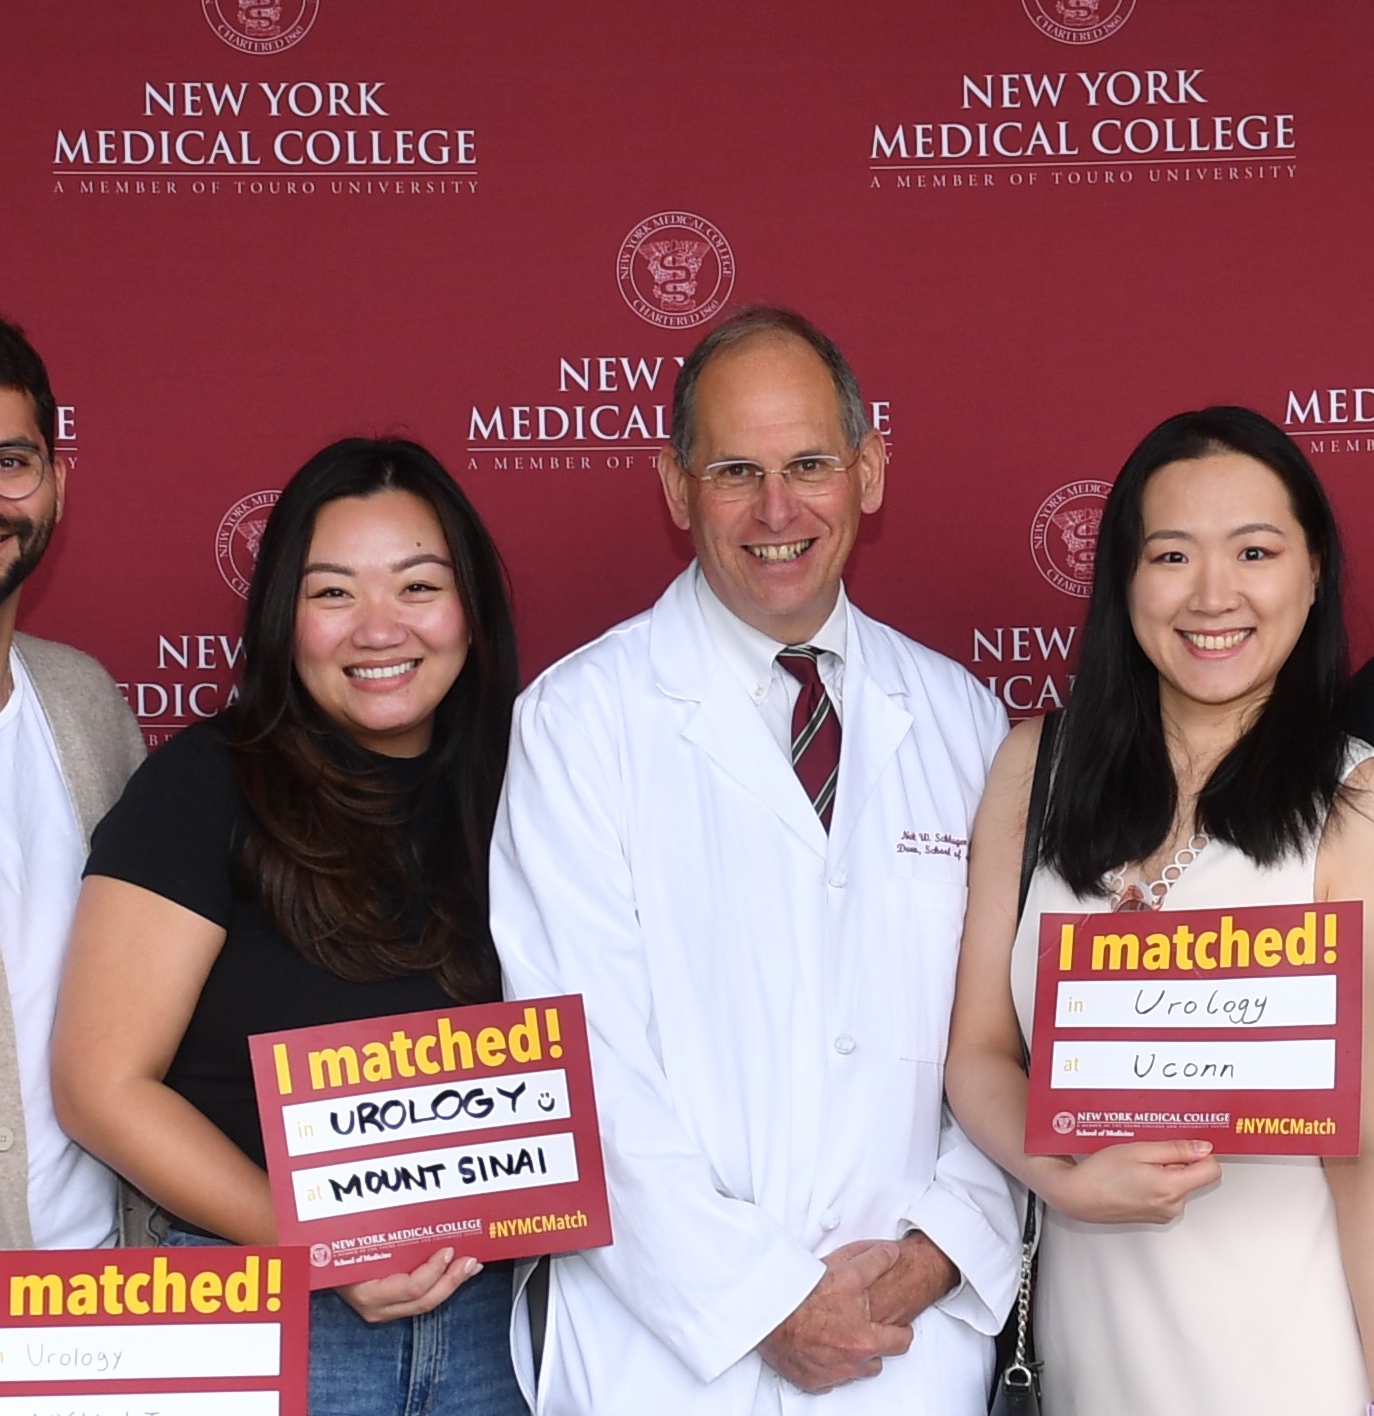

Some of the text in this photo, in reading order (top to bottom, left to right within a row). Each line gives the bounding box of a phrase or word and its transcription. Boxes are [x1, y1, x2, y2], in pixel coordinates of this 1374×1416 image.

[217, 25, 284, 51] CHARTERED
[145, 82, 389, 116] NEW YORK
[963, 70, 1207, 108] NEW YORK
[54, 130, 476, 165] MEDICAL COLLEGE
[871, 115, 1295, 158] MEDICAL COLLEGE
[54, 181, 478, 194] A MEMBER OF TOURO UNIVERSITY
[870, 165, 1296, 188] A MEMBER OF TOURO UNIVERSITY
[559, 357, 663, 391] NEW
[468, 405, 670, 440] MEDICAL
[468, 456, 633, 470] A MEMBER OF
[973, 626, 1076, 662] NEW
[1059, 912, 1337, 971] I matched!
[1134, 989, 1268, 1025] Urology
[274, 1008, 562, 1094] I matched!
[1133, 1053, 1235, 1079] Uconn
[329, 1082, 527, 1136] UROLOGY
[1077, 1112, 1229, 1122] NEW YORK MEDICAL COLLEGE
[1235, 1117, 1336, 1135] #NYMCMatch
[328, 1163, 446, 1202] MOUNT
[458, 1147, 547, 1185] SINAI
[332, 1239, 356, 1250] NEW
[357, 1233, 386, 1246] YORK
[388, 1226, 434, 1242] MEDICAL
[436, 1219, 482, 1234] COLLEGE
[488, 1212, 587, 1238] #NYMCMatch
[10, 1255, 282, 1316] matched!
[26, 1343, 123, 1372] Urology
